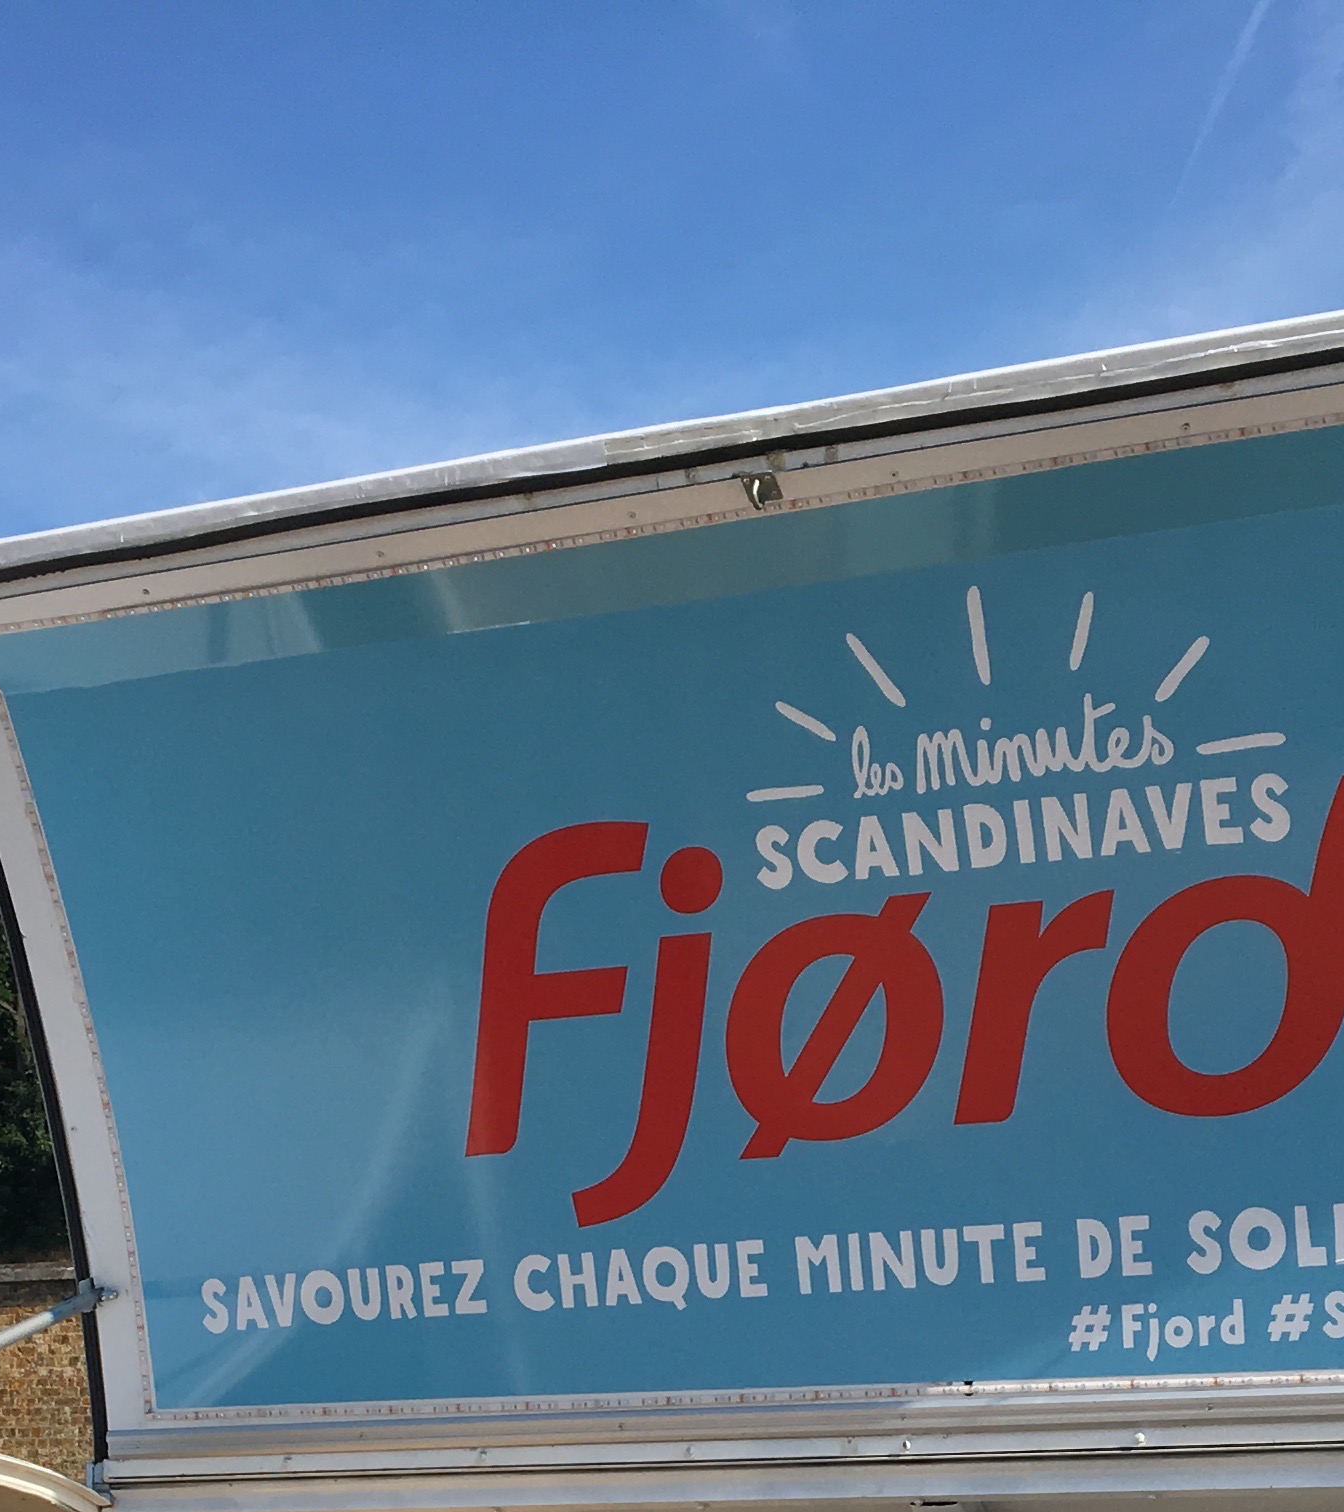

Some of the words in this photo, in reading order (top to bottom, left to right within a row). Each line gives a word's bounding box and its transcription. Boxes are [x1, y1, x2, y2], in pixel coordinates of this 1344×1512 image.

[852, 724, 905, 799] les
[916, 692, 1175, 796] minutes
[756, 772, 1292, 890] SCANDINAVES
[201, 1257, 488, 1335] SAVOUREZ
[512, 1237, 768, 1313] CHAQUE
[794, 1219, 1048, 1295] MINUTE
[1075, 1213, 1155, 1280] DE
[1067, 1297, 1247, 1362] #Fjord
